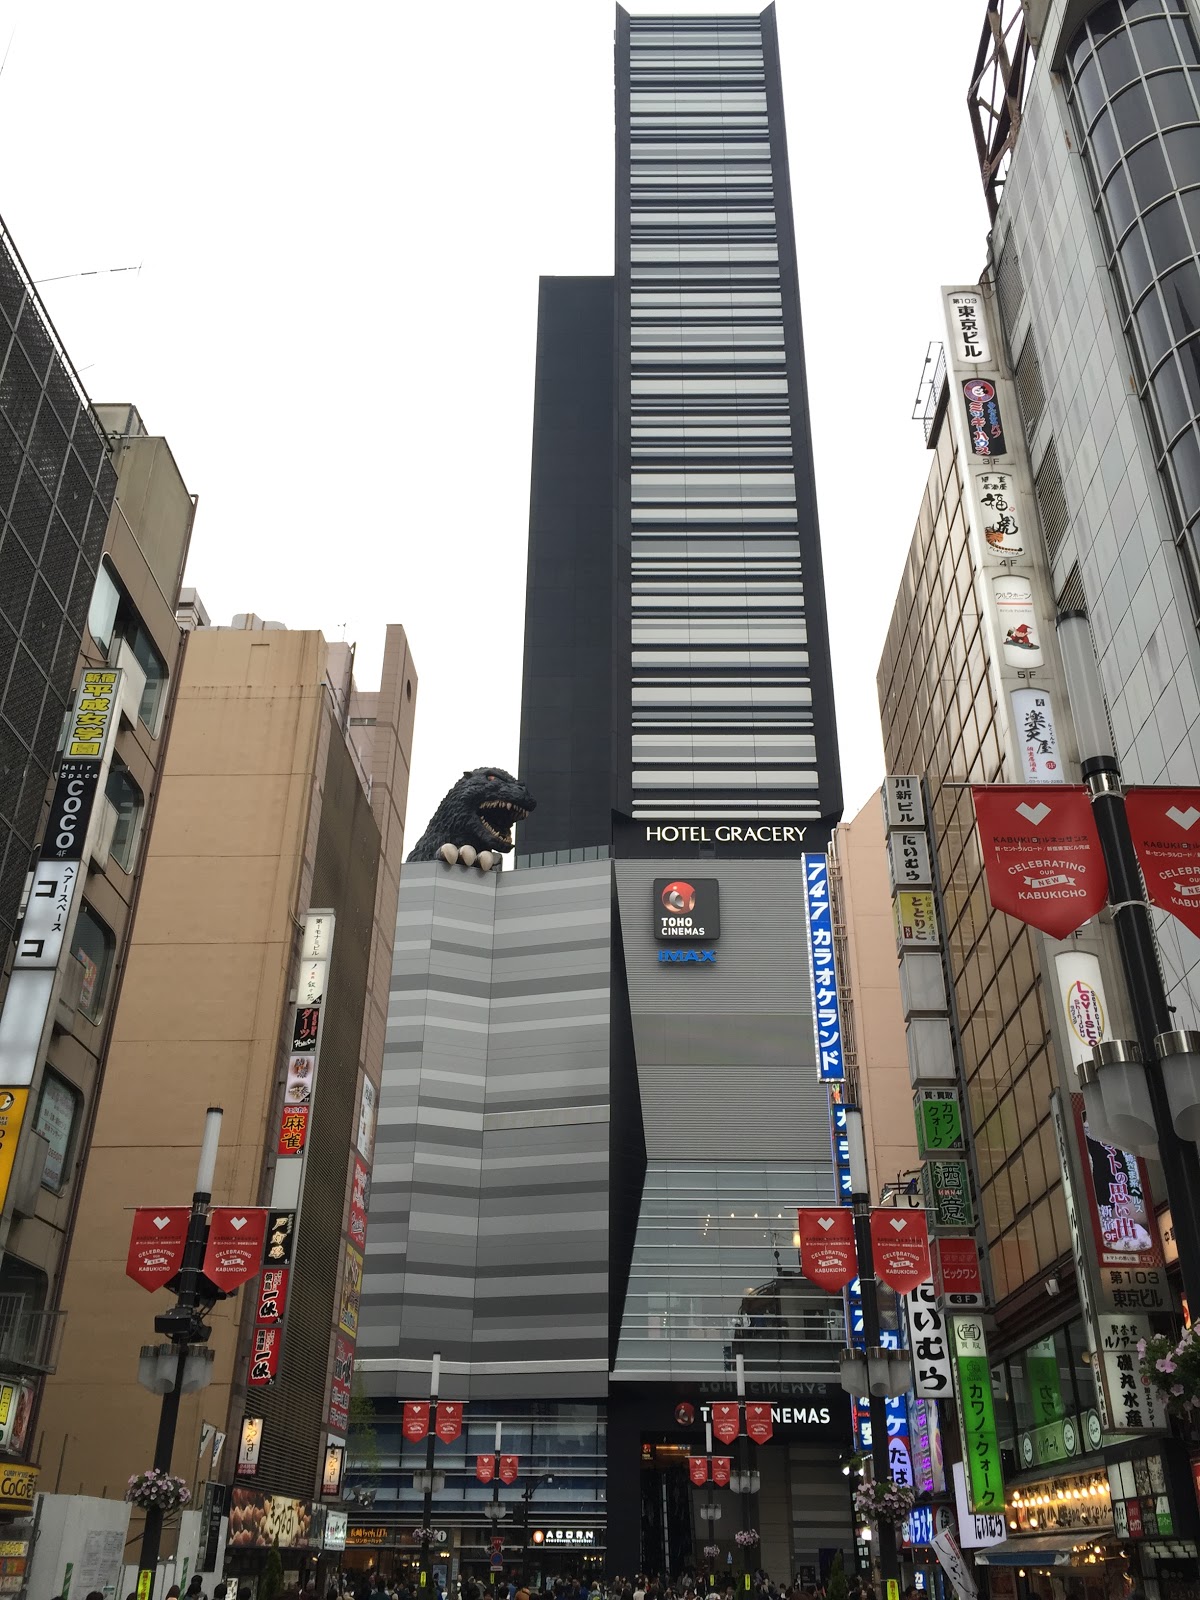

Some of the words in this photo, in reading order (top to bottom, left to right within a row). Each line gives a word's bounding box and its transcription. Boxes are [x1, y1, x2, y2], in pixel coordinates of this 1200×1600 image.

[957, 305, 982, 358] 東京ビル
[969, 401, 991, 455] ミッキーハウス
[85, 672, 117, 684] 新宿
[1017, 671, 1036, 679] 5F
[1024, 709, 1054, 754] 楽天屋
[62, 763, 92, 772] Hair
[60, 772, 98, 781] Space
[895, 779, 915, 822] 川新ビル
[55, 780, 85, 850] COCO
[646, 826, 711, 841] HOTEL
[715, 826, 807, 841] GRACERY
[903, 835, 920, 881] にいむら
[1008, 859, 1086, 875] CELEBRATING
[1038, 877, 1059, 887] NEW
[808, 863, 828, 919] 747
[1018, 889, 1086, 900] KABUKICHO
[51, 866, 74, 932] ヘアースペース
[661, 917, 693, 926] TOHO
[912, 896, 927, 940] ととりこ
[661, 927, 705, 935] CINEMAS
[658, 950, 717, 962] IMAX
[813, 929, 839, 1070] カラオケランド
[925, 1092, 954, 1100] 質・買取
[282, 1114, 305, 1149] 麻雀
[928, 1107, 942, 1147] クォーク
[1101, 1205, 1114, 1231] 新宿
[1105, 1231, 1117, 1241] 9F
[138, 1248, 175, 1258] CELEBRATING
[215, 1248, 252, 1258] CELEBRATING
[811, 1251, 848, 1259] CELEBRATING
[882, 1251, 920, 1261] CELEBRATING
[943, 1268, 978, 1279] ビックワン
[1109, 1271, 1160, 1285] 第103
[956, 1295, 971, 1303] 3F
[1112, 1289, 1164, 1308] 東京ビル
[1110, 1324, 1138, 1336] 喫茶室
[1104, 1336, 1139, 1349] ルノアー
[1116, 1353, 1144, 1428] 磯丸水産
[969, 1384, 995, 1506] カワノ・クォーク
[909, 1508, 933, 1543] カラオケ
[974, 1515, 1003, 1540] にいむら
